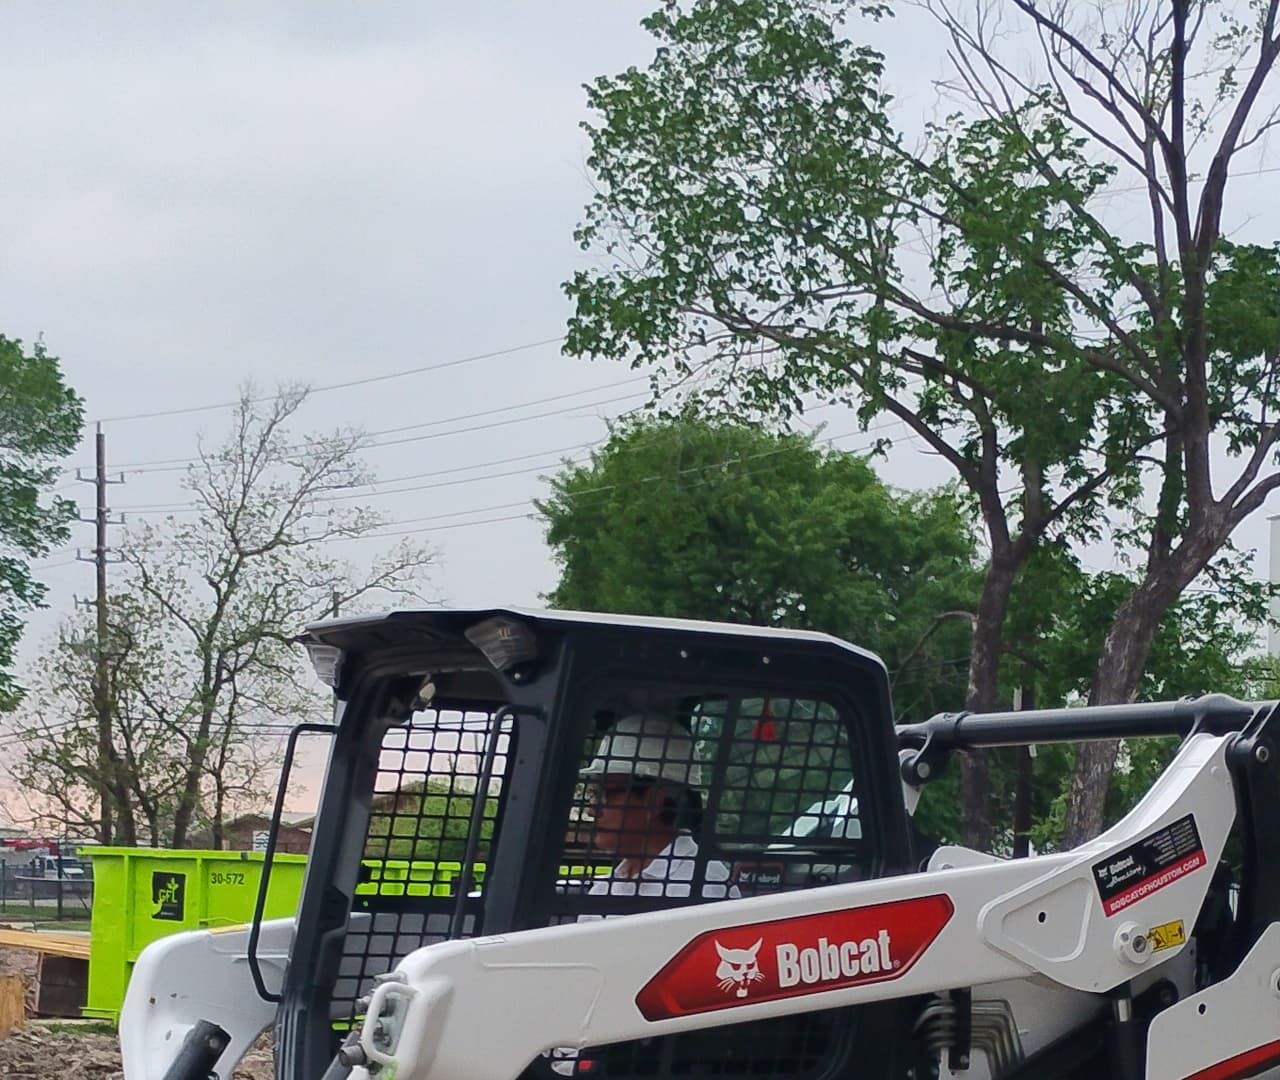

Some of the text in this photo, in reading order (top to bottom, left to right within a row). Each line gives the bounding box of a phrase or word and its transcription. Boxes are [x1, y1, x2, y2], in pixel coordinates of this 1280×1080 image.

[210, 873, 245, 885] 30-572
[1110, 857, 1200, 911] BOBCATOFHOUSTON.COM
[776, 929, 894, 988] Bobcat
